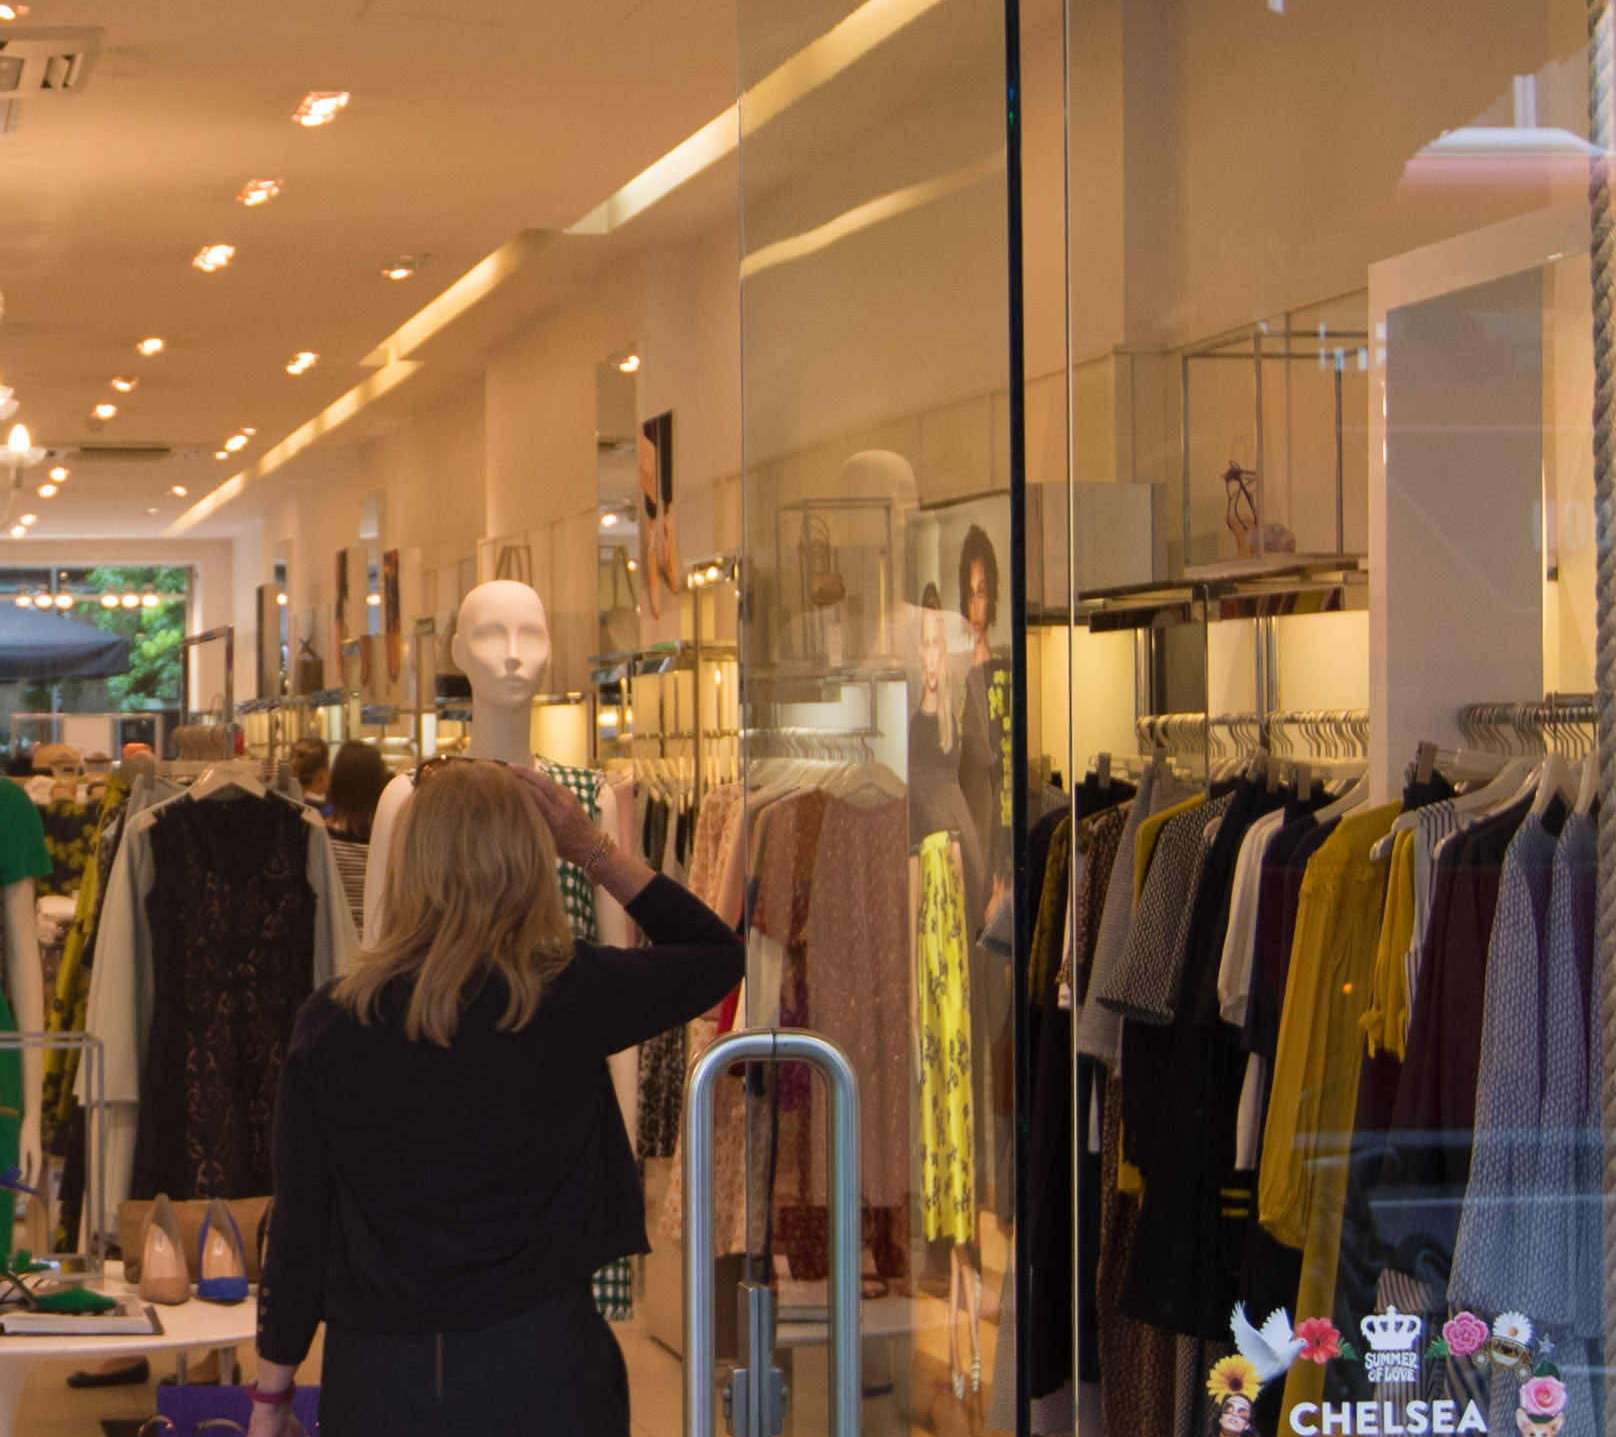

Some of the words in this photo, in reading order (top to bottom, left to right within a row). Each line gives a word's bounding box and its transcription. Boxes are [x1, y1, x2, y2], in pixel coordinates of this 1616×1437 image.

[1364, 1352, 1419, 1370] SUMMER
[1368, 1367, 1384, 1382] OF
[1384, 1366, 1416, 1382] LOVE
[1288, 1400, 1489, 1437] CHELSEA
